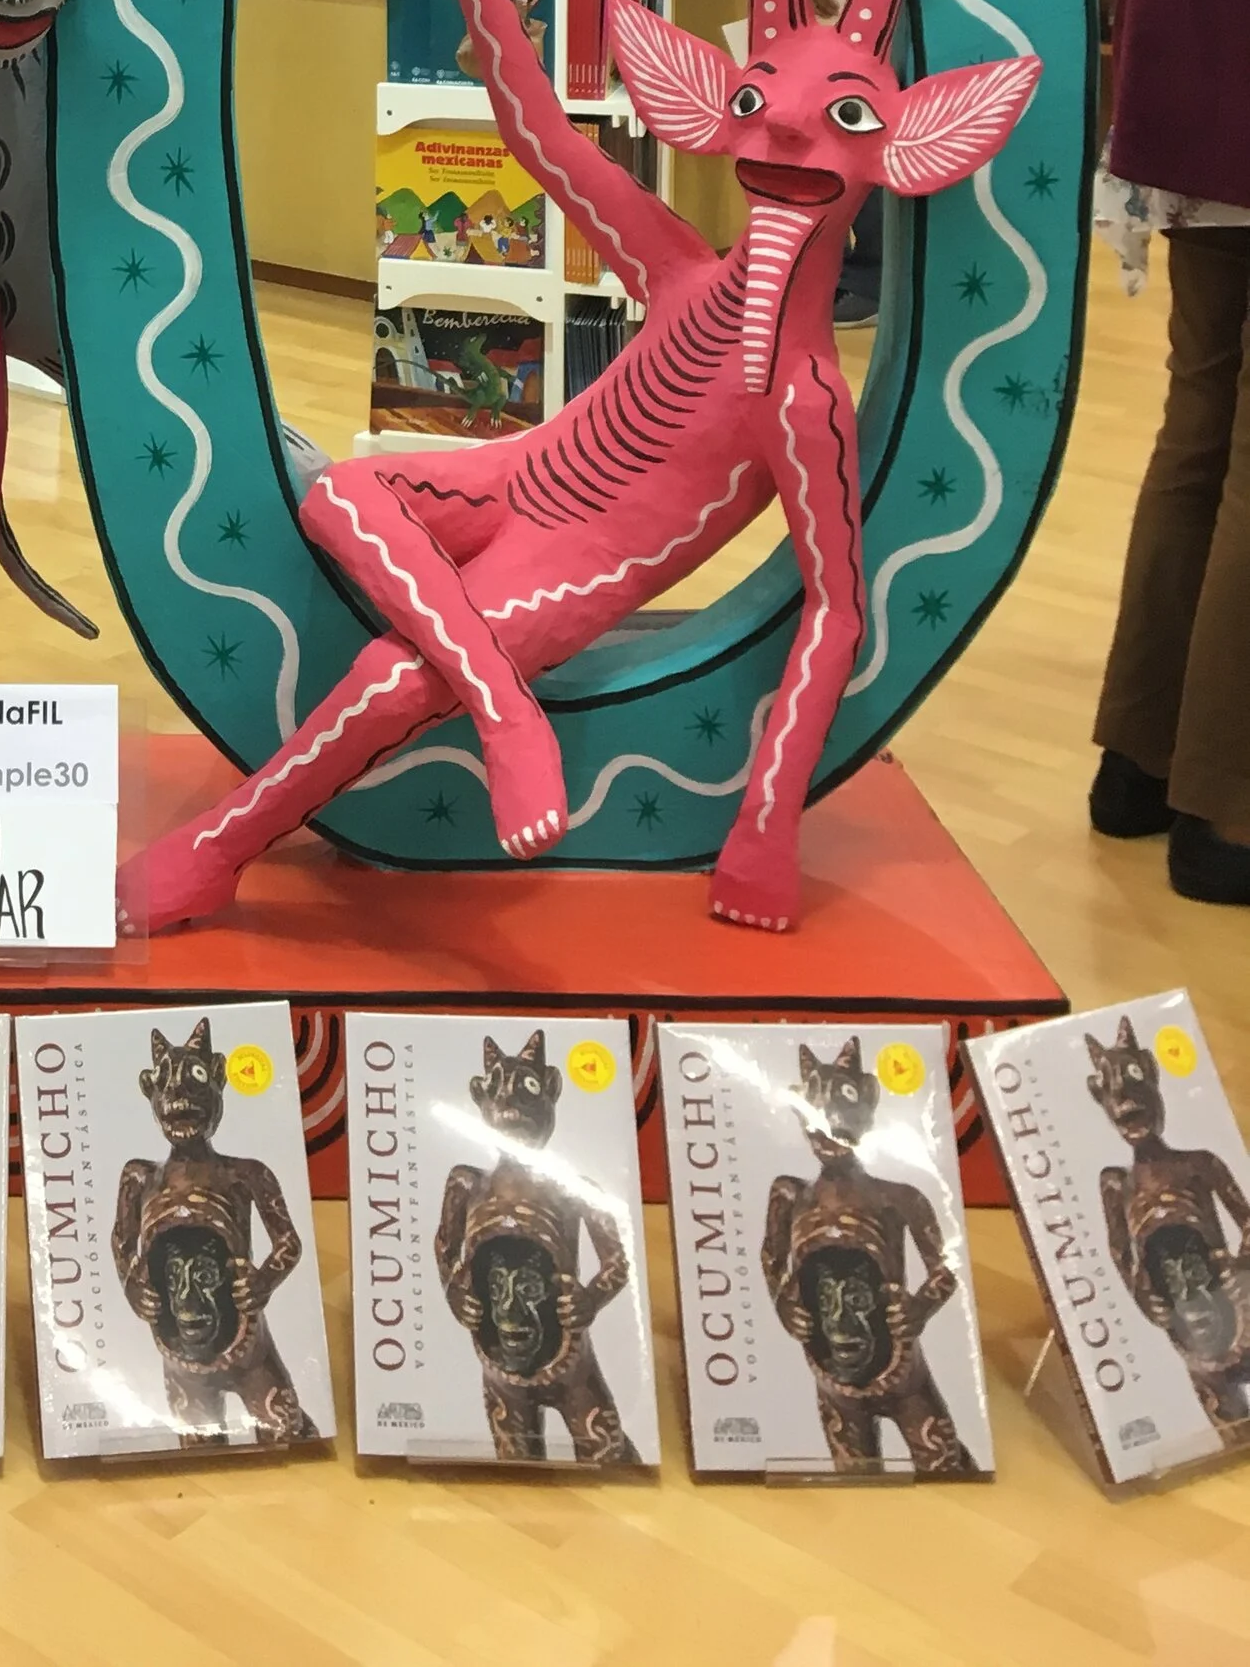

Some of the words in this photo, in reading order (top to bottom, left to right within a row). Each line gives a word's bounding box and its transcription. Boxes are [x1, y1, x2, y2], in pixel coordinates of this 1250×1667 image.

[415, 141, 510, 158] Adivinanzas
[422, 155, 503, 169] mexicanas
[364, 1040, 406, 1372] OCUMICHO
[679, 1051, 739, 1386] OCUMICHO
[995, 1061, 1125, 1392] OCUMICHO
